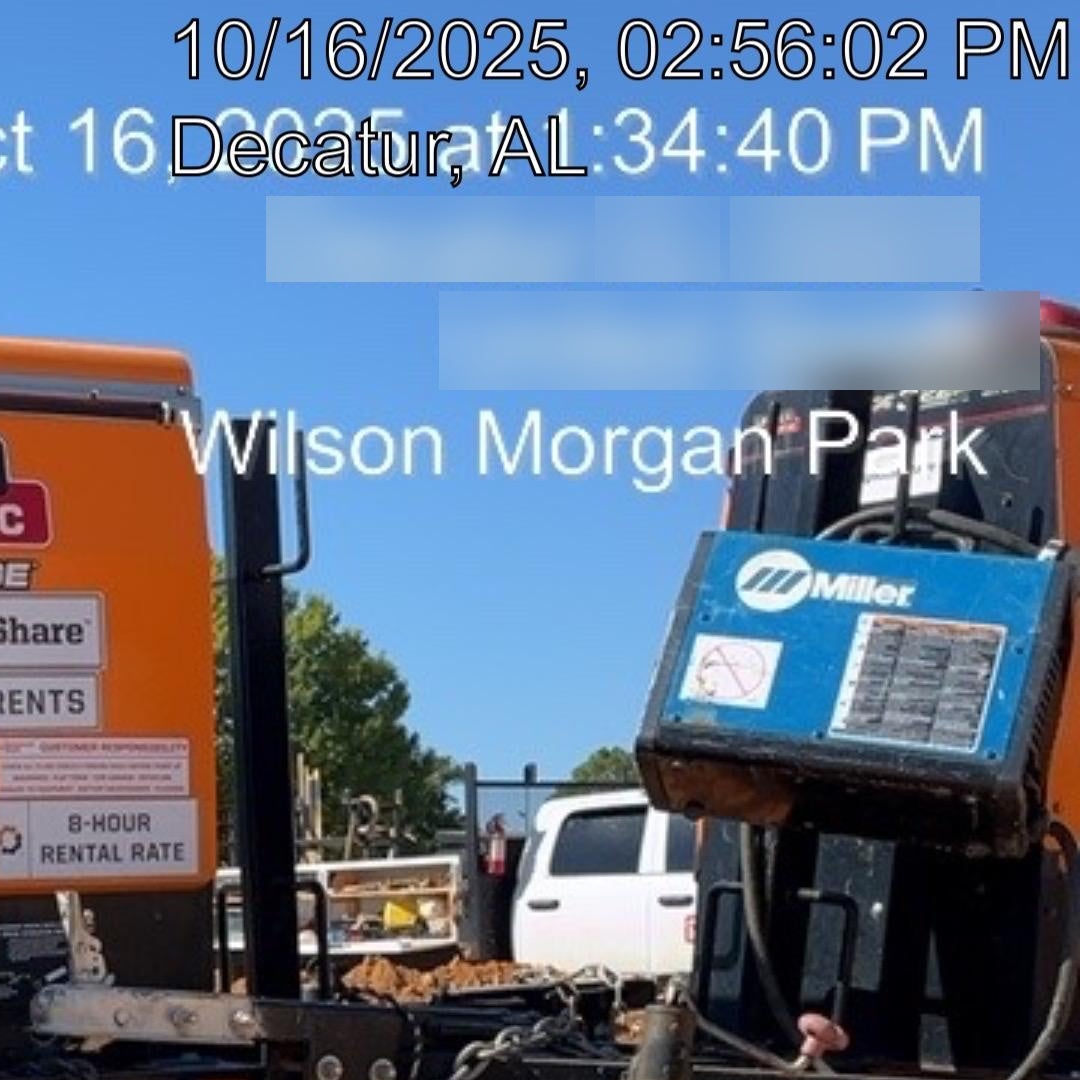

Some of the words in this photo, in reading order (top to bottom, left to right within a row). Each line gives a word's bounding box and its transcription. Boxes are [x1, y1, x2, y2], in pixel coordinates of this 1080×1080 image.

[810, 570, 917, 608] Miller
[67, 812, 152, 833] 8-HOUR
[40, 843, 124, 865] RENTAL
[130, 841, 186, 862] RATE
